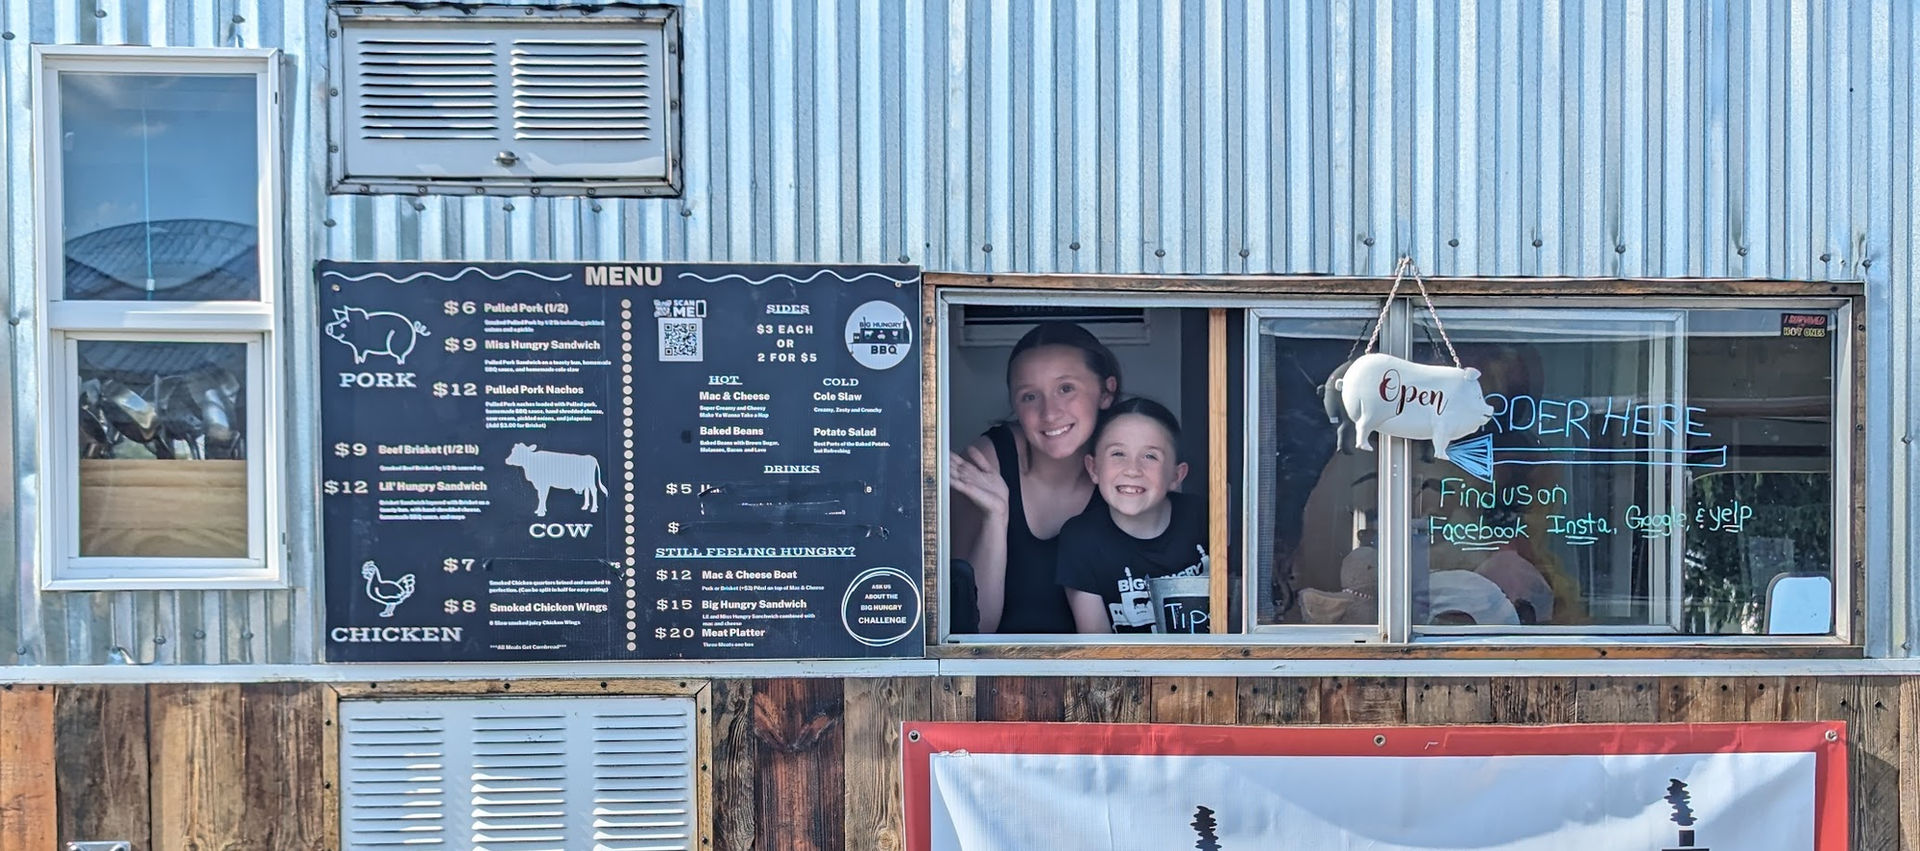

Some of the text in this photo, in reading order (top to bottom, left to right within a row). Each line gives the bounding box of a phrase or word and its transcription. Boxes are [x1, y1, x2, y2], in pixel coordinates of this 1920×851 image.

[585, 266, 662, 287] MENU
[484, 303, 517, 314] Pulled
[520, 303, 543, 314] Pork
[674, 308, 695, 317] ME
[766, 304, 810, 313] SIDES
[757, 325, 814, 334] $3 EACH
[485, 340, 600, 352] Miss Hungry Sandwich
[777, 340, 794, 348] OR
[871, 346, 897, 355] BBQ
[758, 354, 817, 363] 2 FOR $5
[339, 373, 417, 387] PORK
[709, 376, 739, 384] HOT
[823, 378, 859, 386] COLD
[486, 385, 584, 395] Pulled Pork Nachos
[1379, 369, 1449, 416] Open
[700, 392, 770, 401] Mac & Cheese
[814, 392, 862, 401] Cole Slaw
[1483, 393, 1712, 440] RDER HERE
[700, 427, 764, 435] Baked Beans
[814, 428, 876, 436] Potato Salad
[378, 445, 403, 455] Beef
[404, 445, 442, 455] Brisket
[464, 444, 479, 456] lb)
[764, 464, 820, 473] DRINKS
[379, 482, 487, 493] Lil' Hungry Sandwich
[1440, 478, 1568, 509] Find us on
[1428, 514, 1529, 545] Facebook
[1546, 511, 1617, 534] Insta,
[1625, 505, 1690, 536] Google,
[1709, 500, 1753, 532] yelp
[529, 524, 593, 538] COW
[656, 546, 856, 557] STILL FEELING HUNGRY?
[702, 570, 797, 579] Mac & Cheese Boat
[1118, 578, 1145, 592] BIG
[490, 603, 608, 613] Smoked Chicken Wings
[702, 600, 807, 610] Big Hungry Sandwich
[1164, 603, 1211, 634] Tip
[331, 628, 463, 642] CHICKEN
[702, 629, 765, 637] Meat Platter
